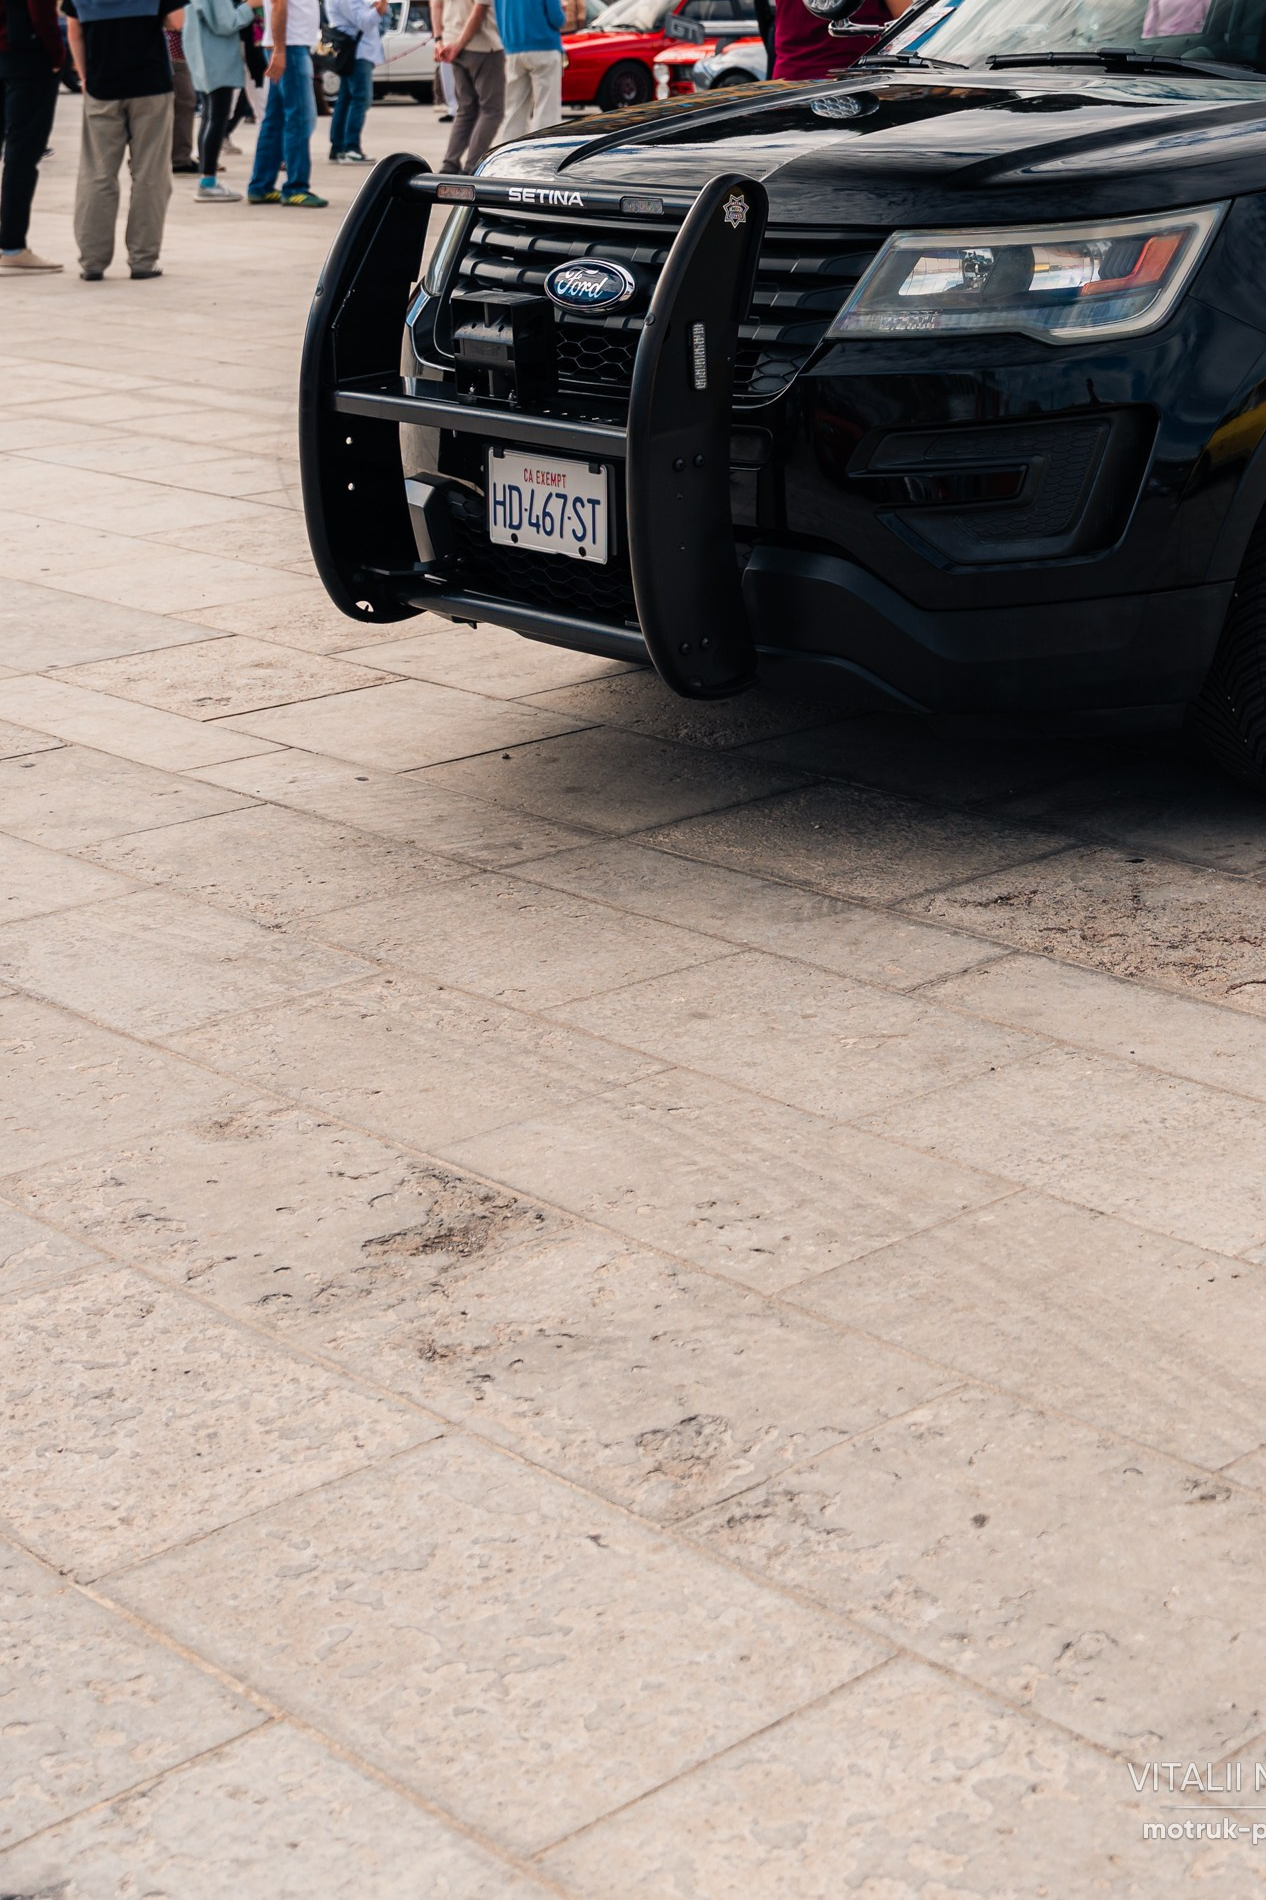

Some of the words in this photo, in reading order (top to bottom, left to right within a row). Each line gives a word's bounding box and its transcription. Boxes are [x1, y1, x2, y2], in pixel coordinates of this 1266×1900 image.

[508, 187, 584, 207] SETINA
[556, 265, 609, 298] Ford
[523, 467, 534, 483] CA
[536, 470, 567, 488] EXEMPT
